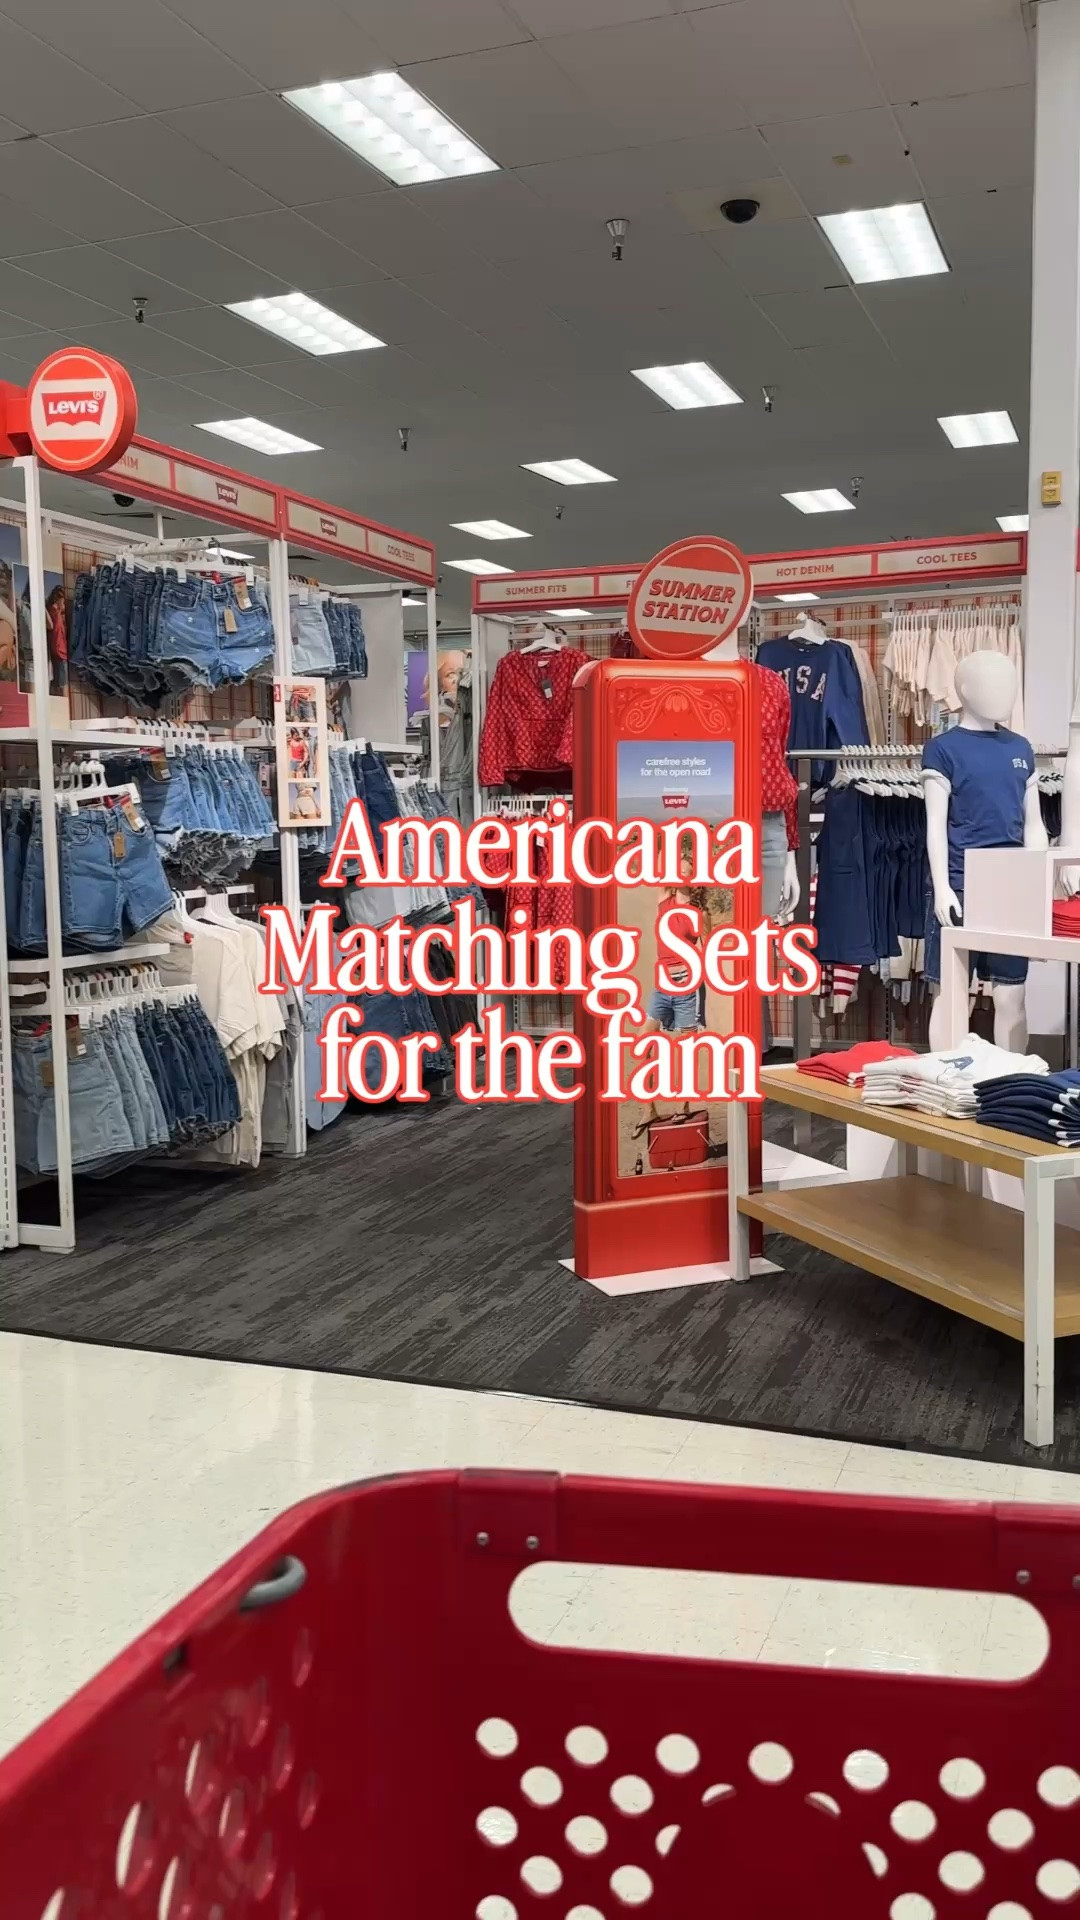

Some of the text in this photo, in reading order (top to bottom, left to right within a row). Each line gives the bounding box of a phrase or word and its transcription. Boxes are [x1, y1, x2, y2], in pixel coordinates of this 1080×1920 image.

[916, 551, 977, 565] COOL TEES
[776, 563, 835, 577] HOT DENIM
[505, 584, 567, 596] SUMMER FITS
[649, 578, 736, 604] SUMMER
[642, 600, 729, 624] STATION
[645, 757, 707, 767] carefree styles
[1011, 757, 1029, 770] USA
[640, 767, 712, 778] for the open road
